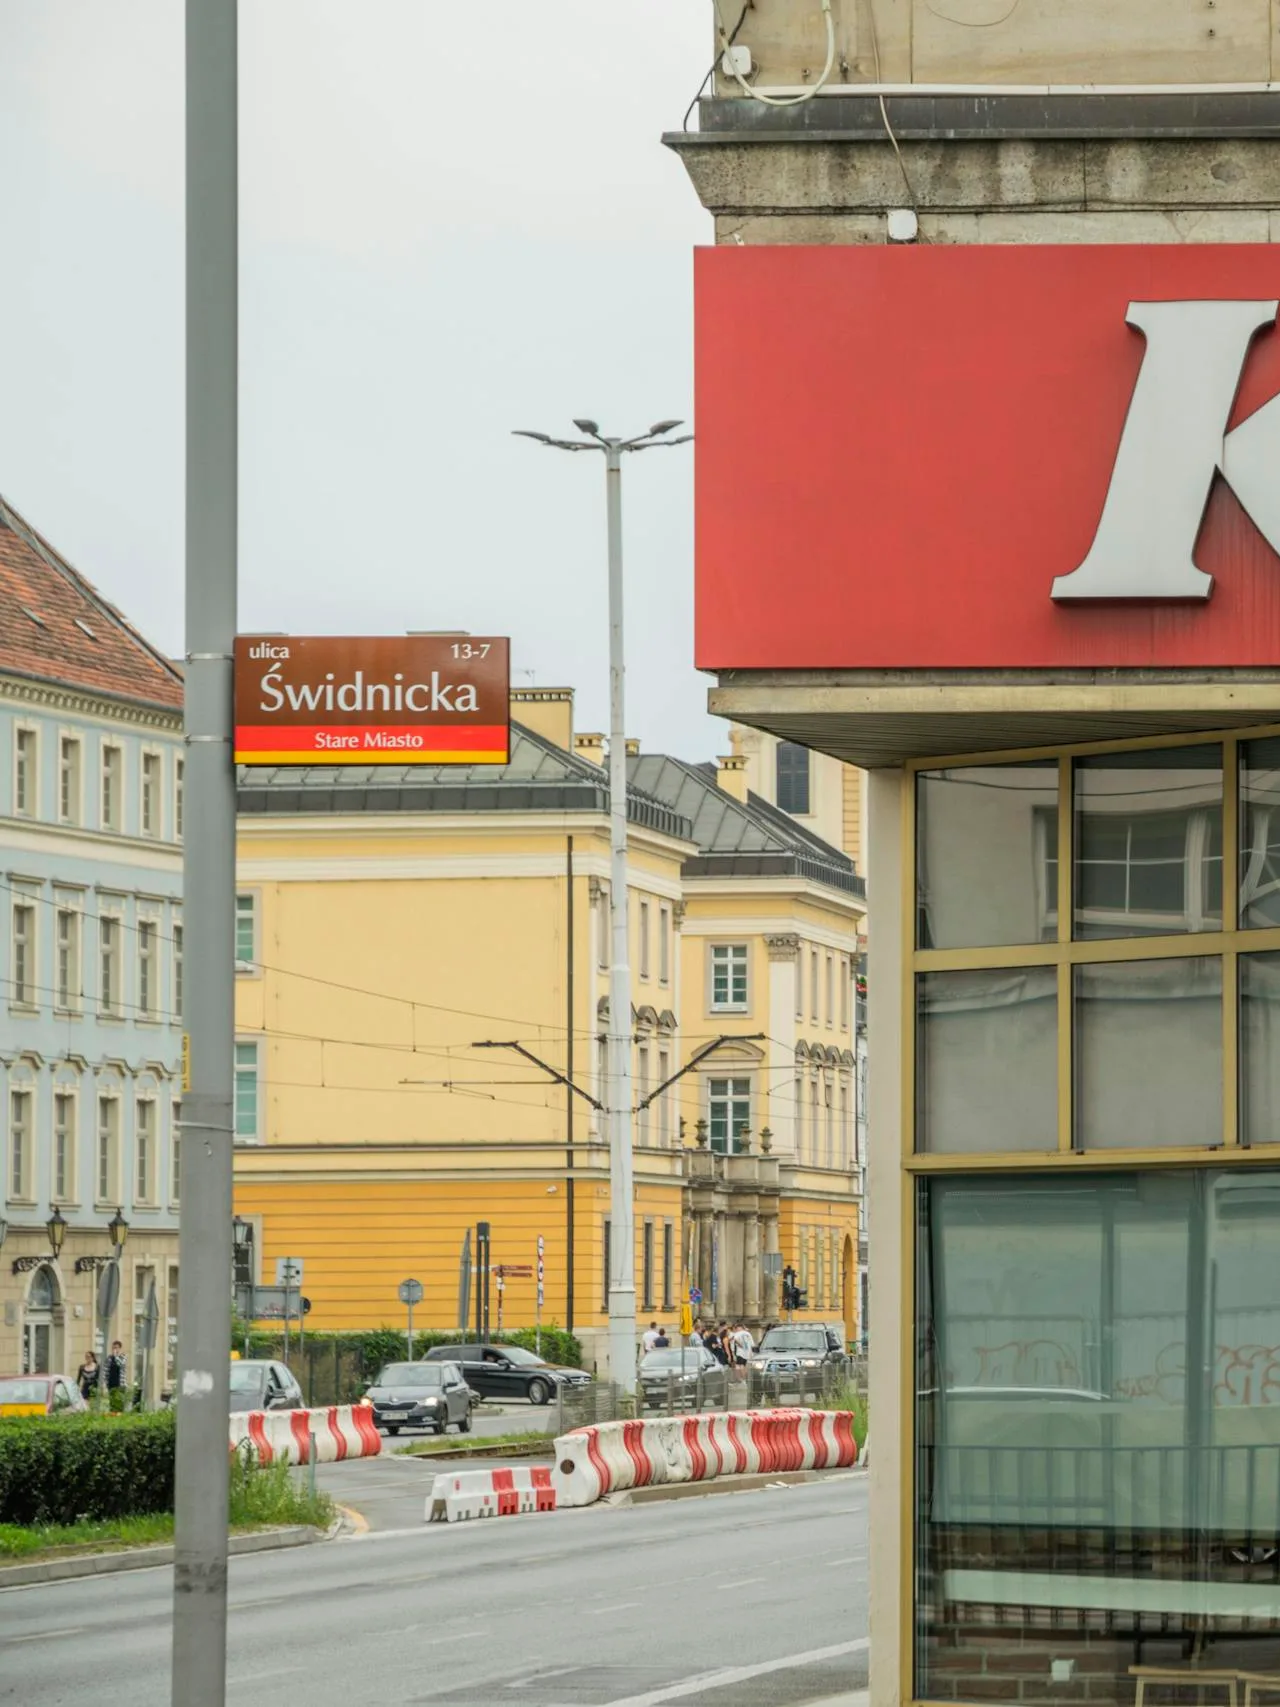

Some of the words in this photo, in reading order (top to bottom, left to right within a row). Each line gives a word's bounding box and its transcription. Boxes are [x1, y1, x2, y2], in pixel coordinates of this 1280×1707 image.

[249, 642, 290, 659] ulica
[450, 643, 490, 658] 13-7
[259, 662, 480, 712] Świdnicka
[314, 732, 359, 748] Stare
[363, 731, 424, 748] Miasto
